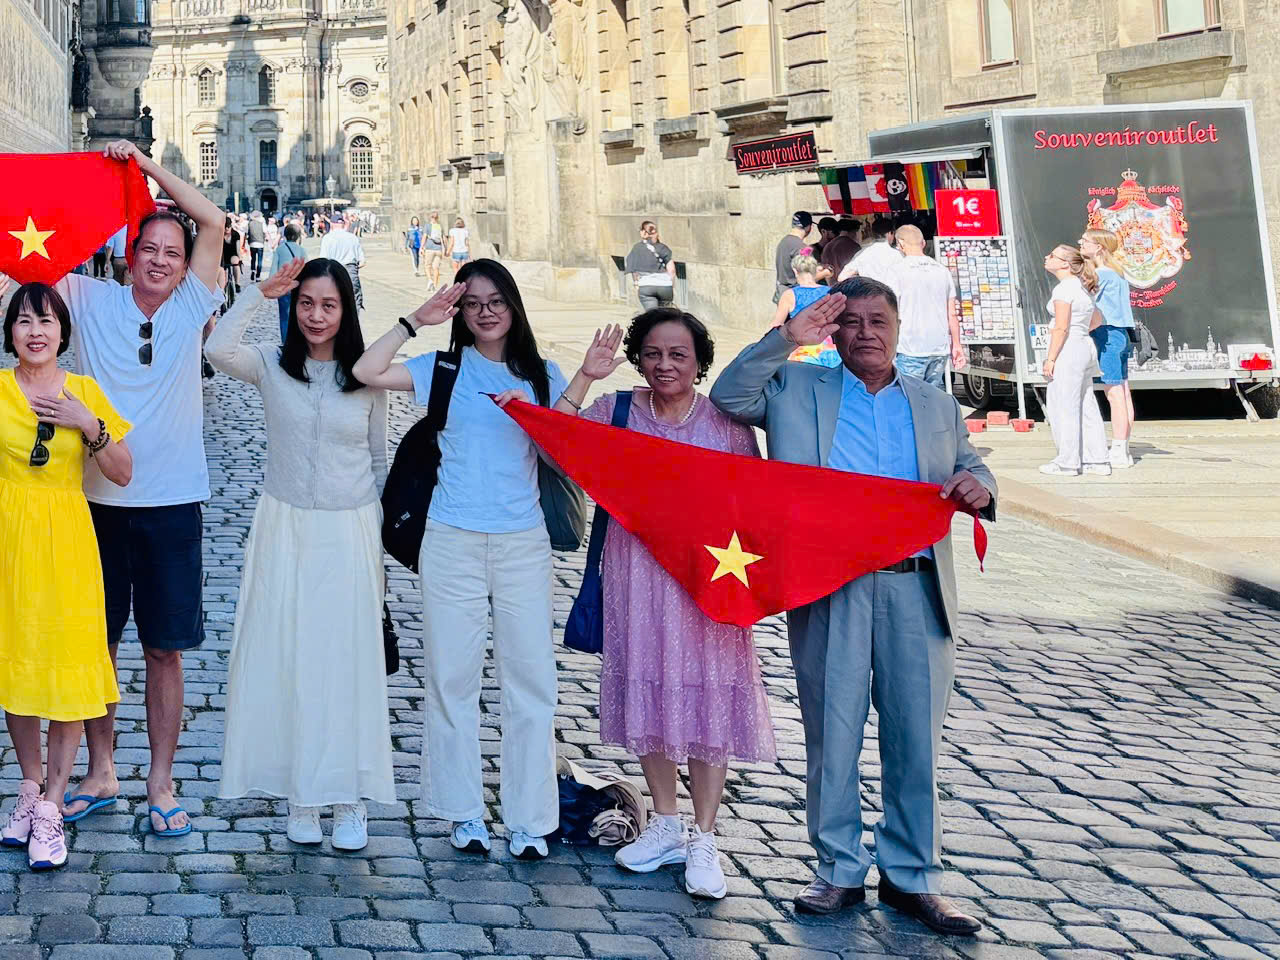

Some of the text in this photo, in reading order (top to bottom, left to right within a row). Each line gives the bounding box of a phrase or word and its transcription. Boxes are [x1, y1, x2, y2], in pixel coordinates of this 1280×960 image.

[1033, 120, 1219, 150] Souveniroutlet
[737, 137, 813, 168] Souveniroutlet
[952, 196, 980, 215] 1€
